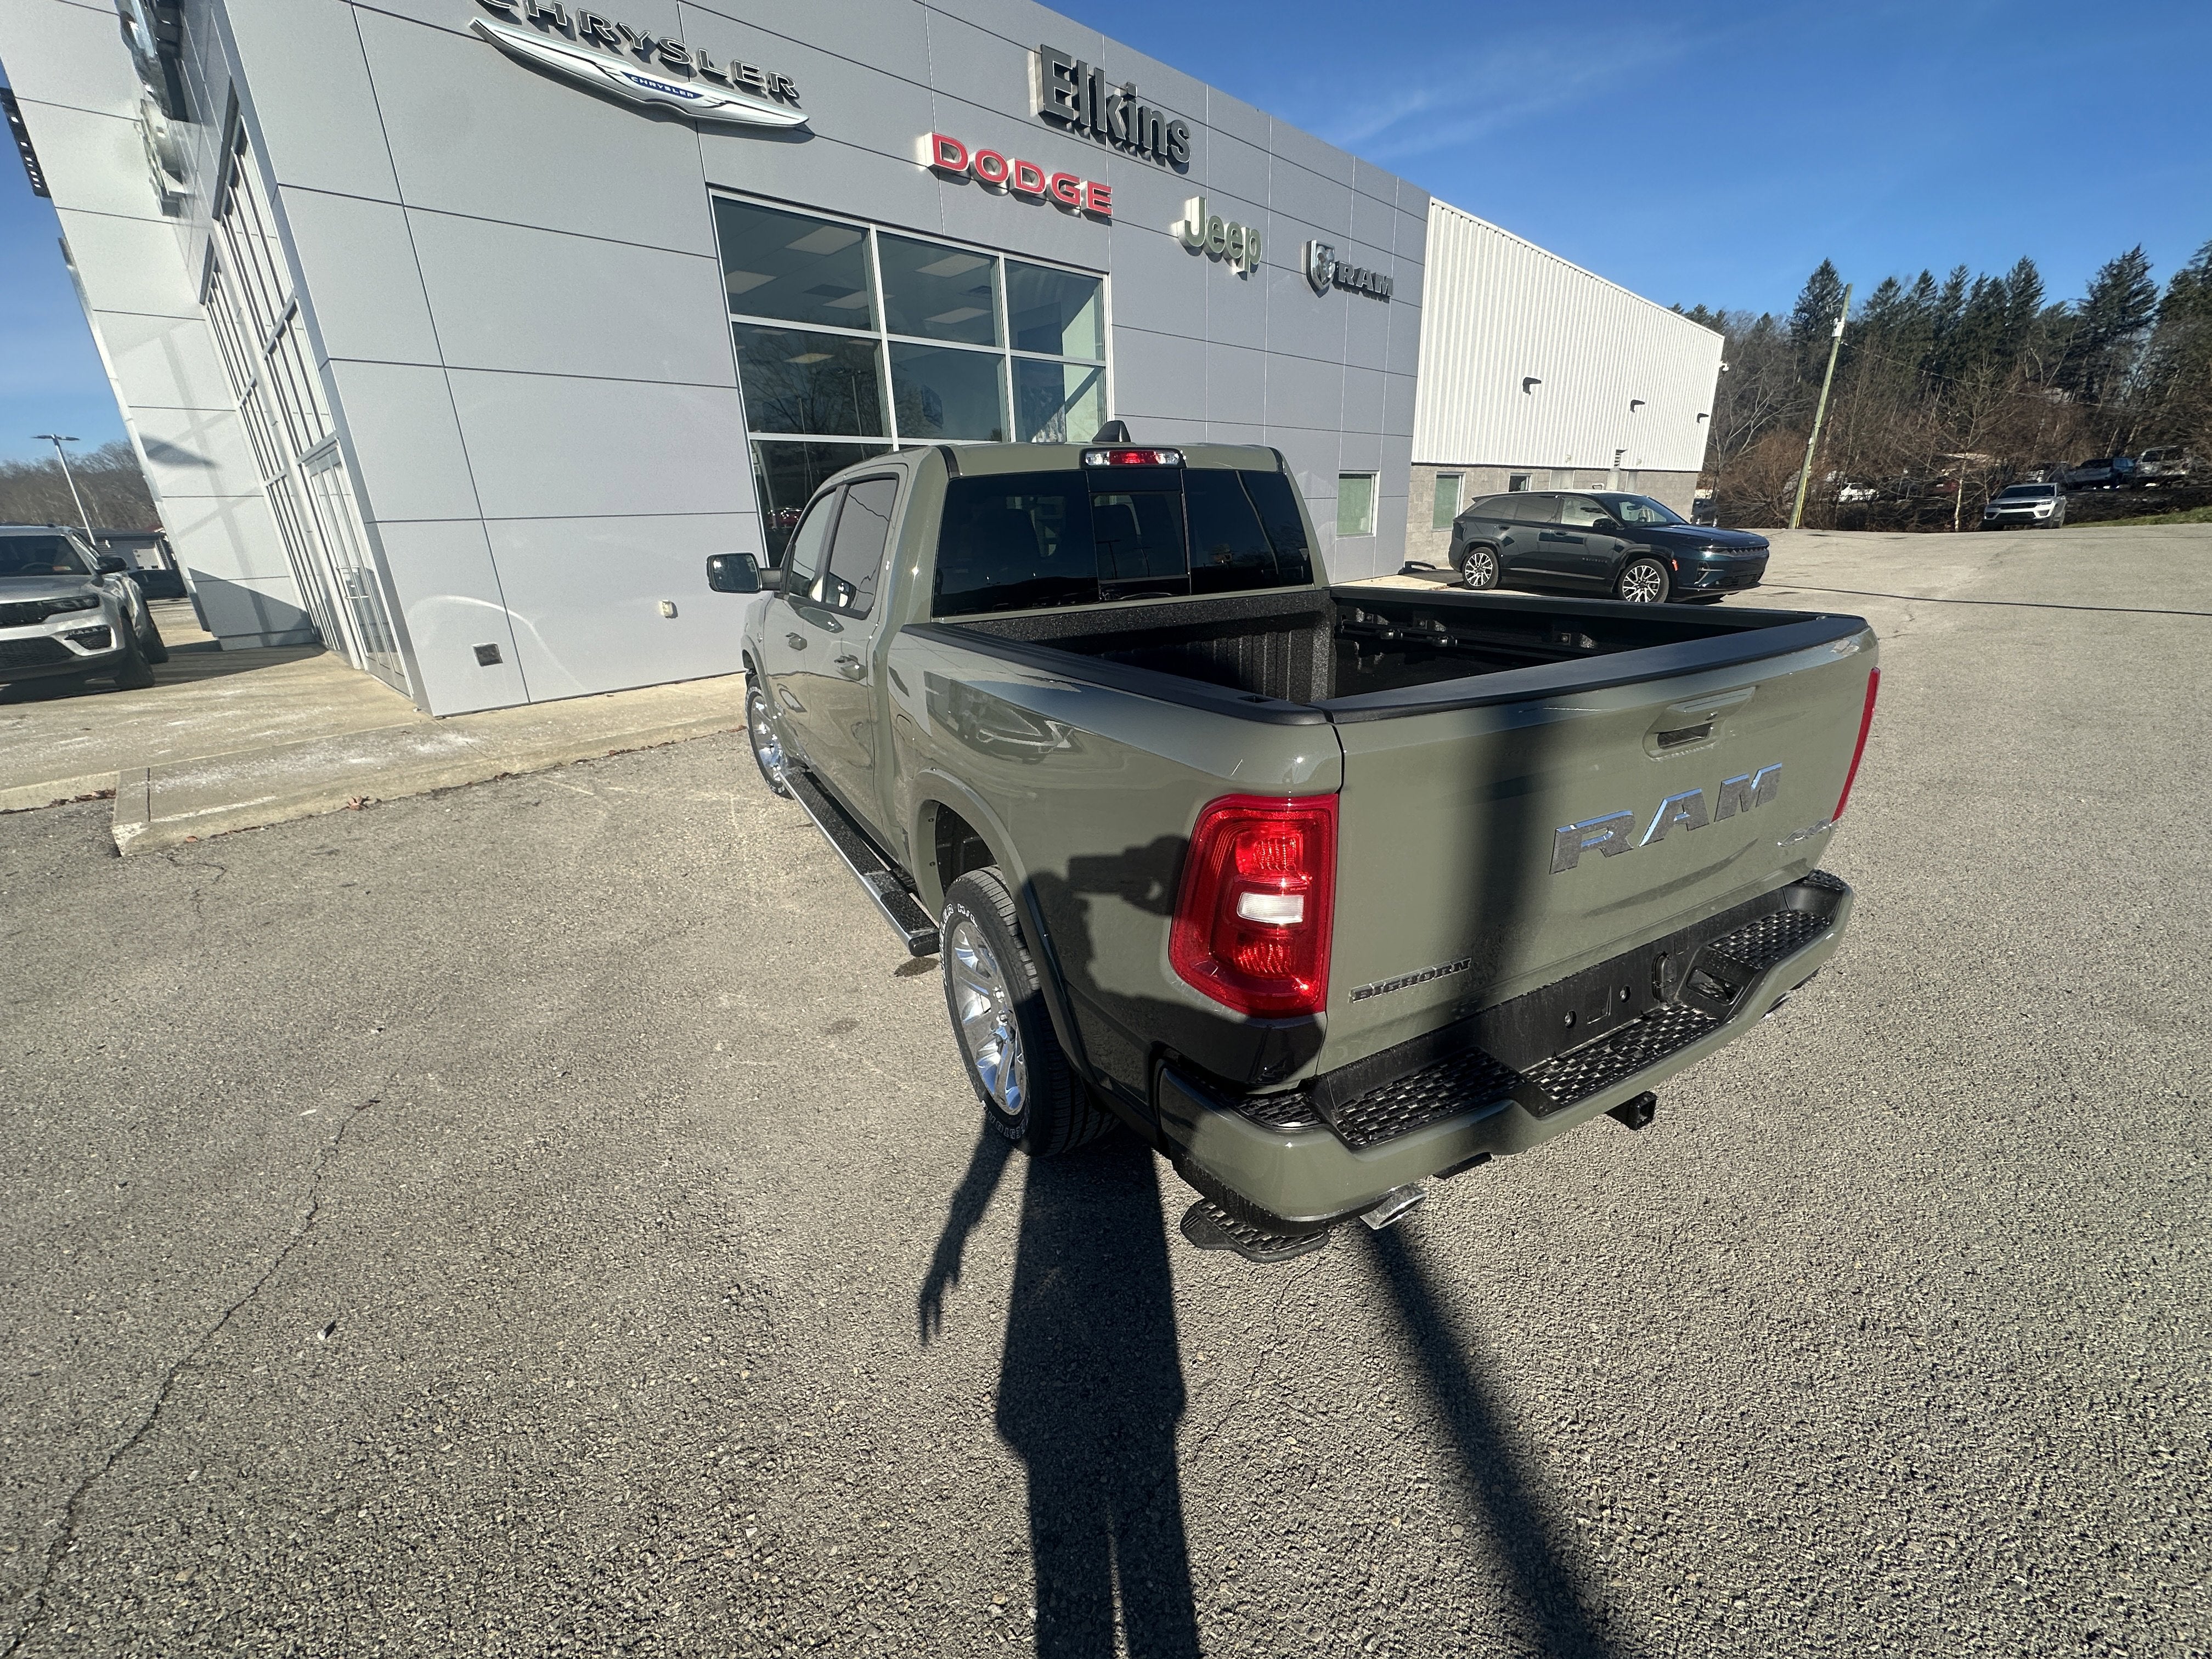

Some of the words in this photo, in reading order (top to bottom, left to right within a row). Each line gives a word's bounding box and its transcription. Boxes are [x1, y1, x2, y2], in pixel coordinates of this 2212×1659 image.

[630, 76, 693, 98] CHRYSLER
[1037, 44, 1192, 163] Elkins
[928, 132, 1113, 216] DODGE
[1178, 195, 1262, 273] Jeep
[1336, 260, 1394, 297] RAM
[1549, 763, 1782, 875] RAM
[1348, 956, 1472, 1004] BIGHORN
